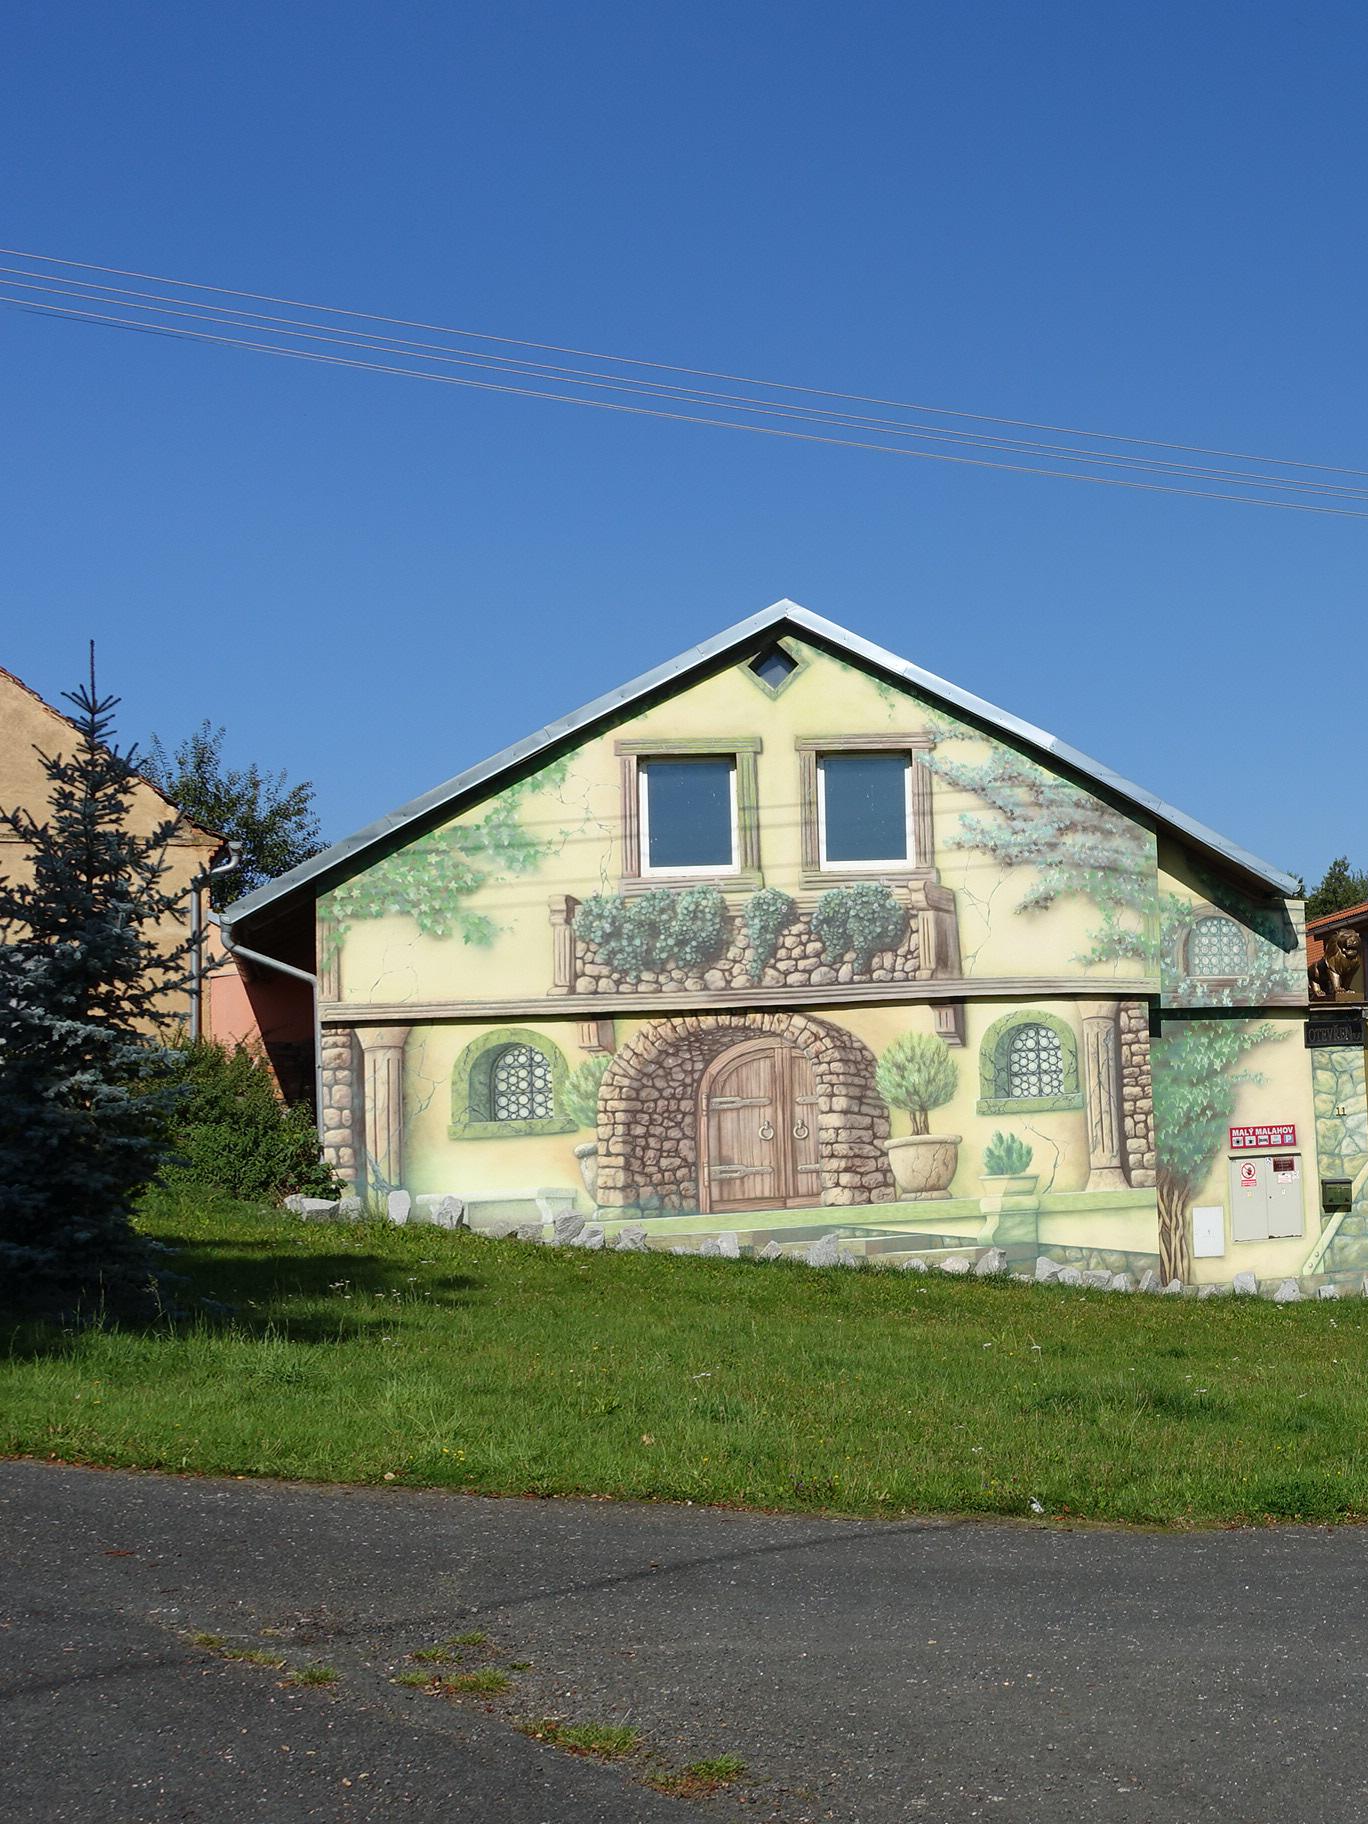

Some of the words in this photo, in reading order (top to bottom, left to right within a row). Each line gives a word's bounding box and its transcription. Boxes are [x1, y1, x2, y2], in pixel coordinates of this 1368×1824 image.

[1335, 1106, 1347, 1117] 11
[1232, 1128, 1254, 1137] MALÝ
[1255, 1126, 1294, 1136] MALAHOV
